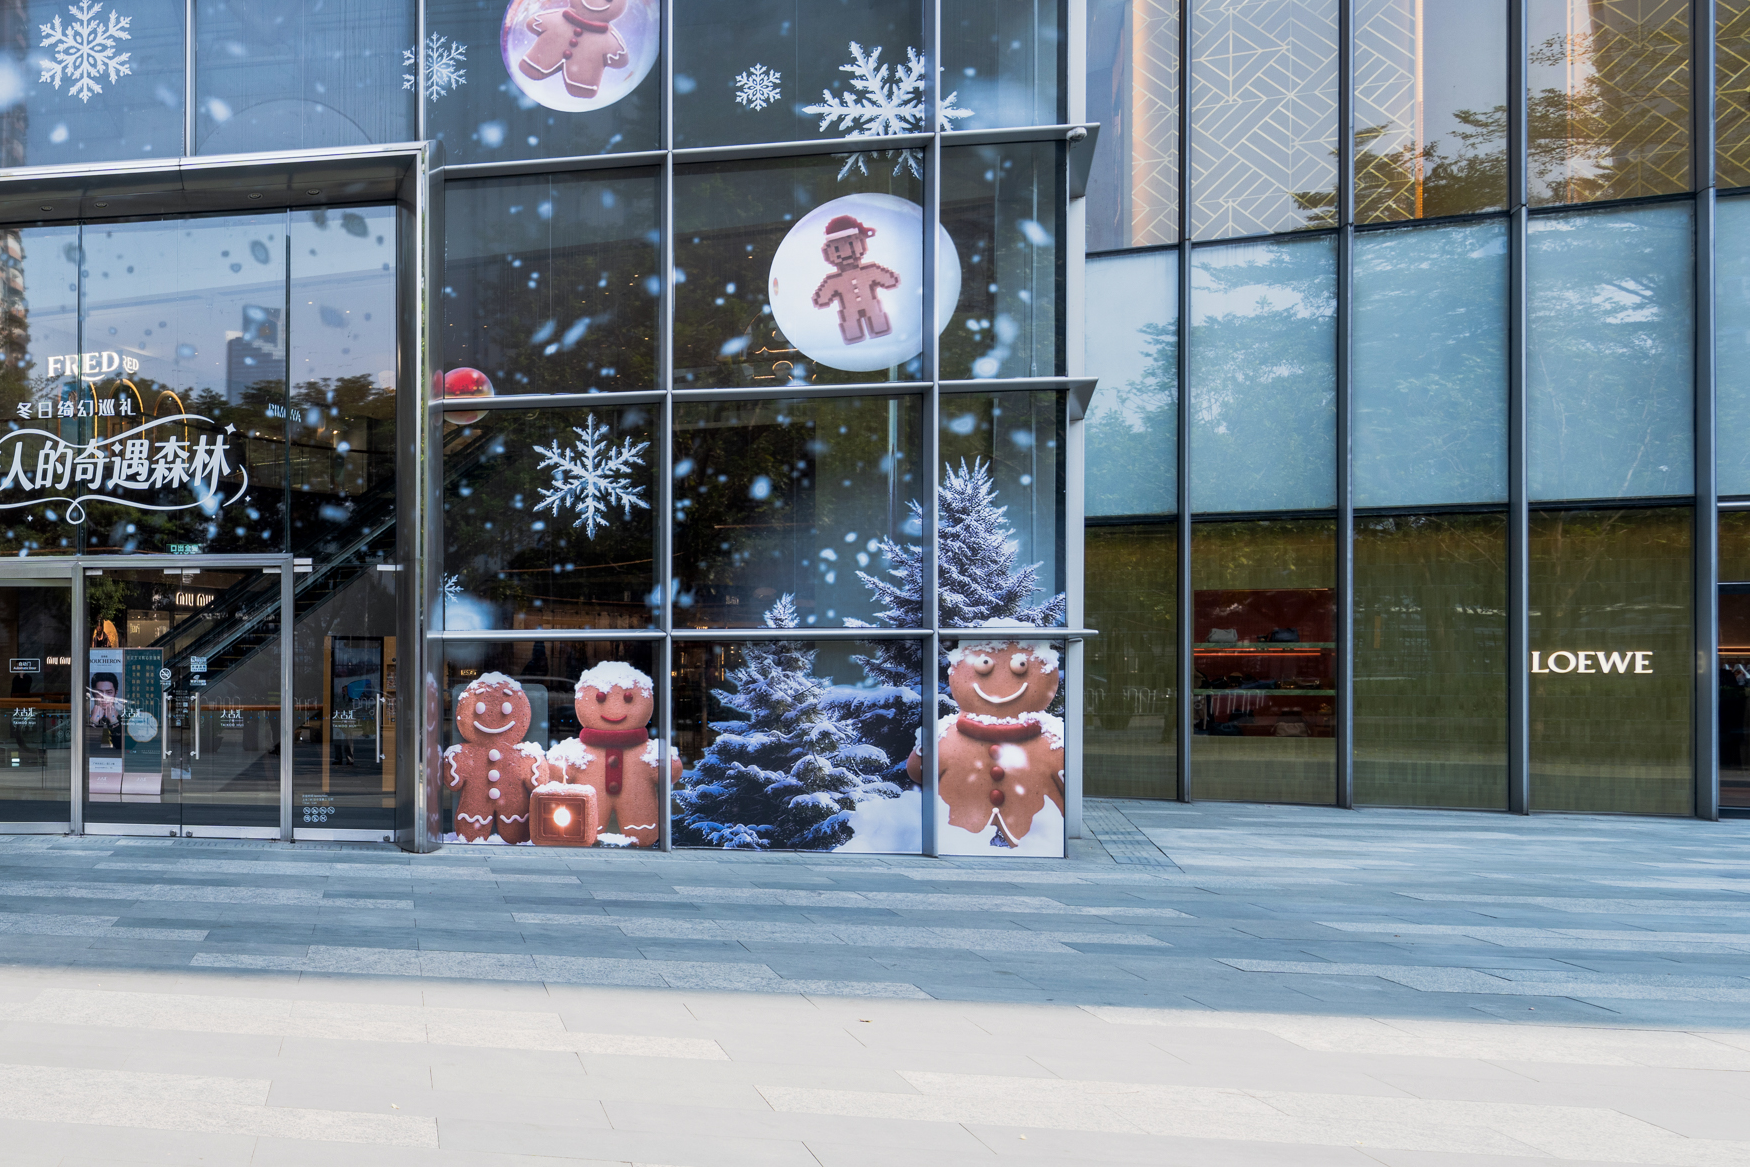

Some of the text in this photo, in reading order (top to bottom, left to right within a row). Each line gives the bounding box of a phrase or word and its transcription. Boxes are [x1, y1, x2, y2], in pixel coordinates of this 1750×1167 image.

[47, 351, 120, 381] FRED
[16, 397, 136, 419] 冬日绮幻巡礼
[268, 402, 302, 423] RIMWA
[1531, 650, 1654, 674] LOEWE
